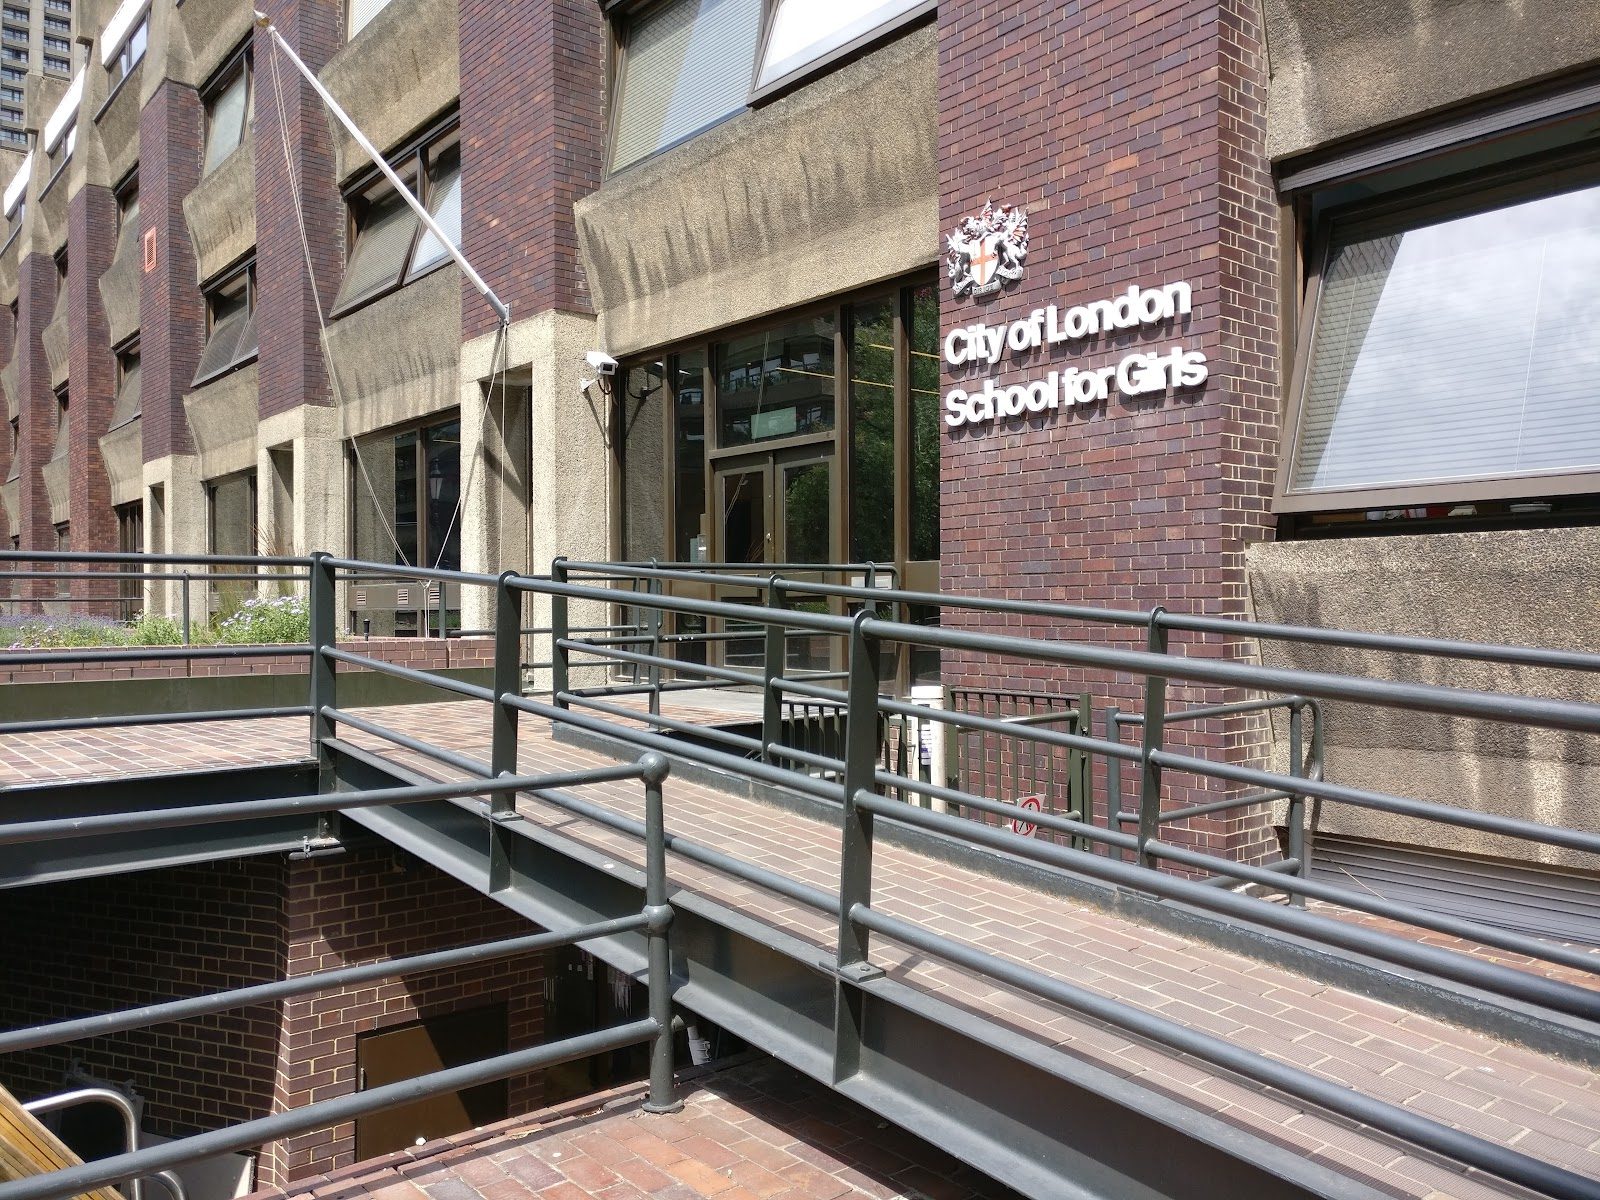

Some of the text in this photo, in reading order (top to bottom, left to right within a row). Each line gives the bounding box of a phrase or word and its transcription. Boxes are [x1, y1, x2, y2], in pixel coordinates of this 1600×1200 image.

[945, 281, 1192, 365] City of London
[944, 346, 1209, 427] School for Girls
